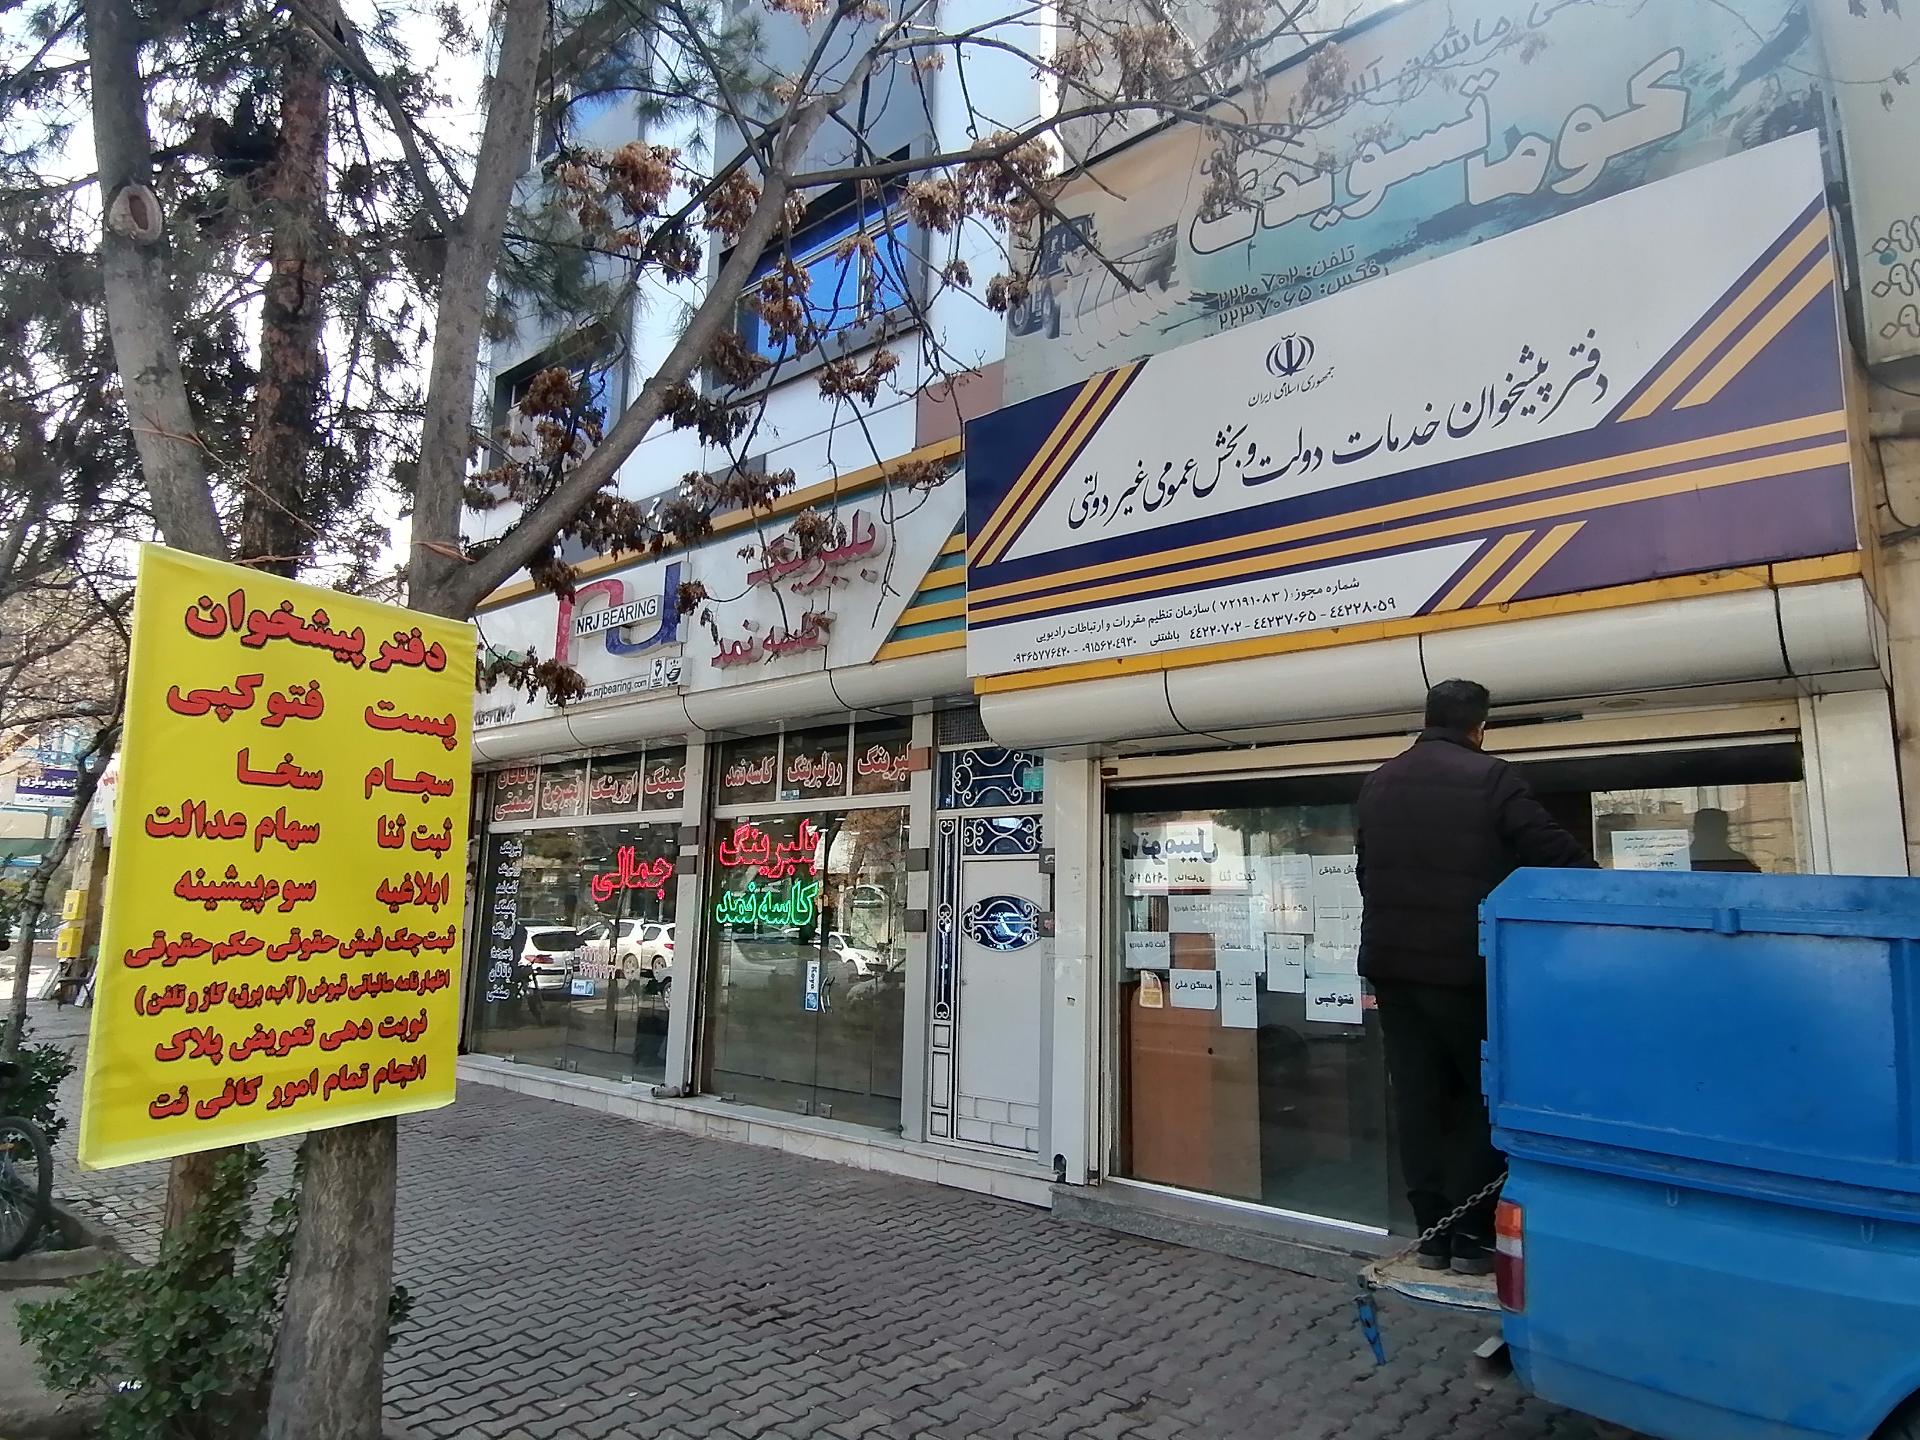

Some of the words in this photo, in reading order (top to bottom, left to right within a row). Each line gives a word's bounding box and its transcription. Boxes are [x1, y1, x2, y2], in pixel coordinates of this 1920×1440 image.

[1274, 382, 1299, 400] اسلامی
[1301, 366, 1335, 392] جمهوری
[1446, 342, 1553, 440] پیشخوان
[1537, 327, 1611, 424] دفتر
[1248, 392, 1272, 407] ایران
[1332, 402, 1441, 466] خدمات
[1192, 423, 1248, 498] بخش
[1242, 426, 1323, 487] دولت
[1068, 471, 1109, 529] دولتی
[1103, 457, 1148, 527] غیر
[1143, 458, 1198, 512] عمومی
[1326, 577, 1360, 595] شماره
[184, 588, 366, 670] پیشخوان
[576, 616, 600, 634] NRJ
[602, 598, 656, 628] BEARING
[1067, 619, 1104, 636] ارتباطات
[1112, 614, 1146, 628] مقررات
[1148, 609, 1173, 628] تنظیم
[1175, 603, 1210, 619] سازمان
[369, 626, 447, 672] دفتر
[1036, 626, 1066, 643] رادیویی
[364, 701, 457, 750] پست
[237, 747, 323, 790] سخا
[725, 758, 746, 788] نمد
[746, 755, 775, 786] کاسه
[787, 751, 843, 788] رولبرینگ
[857, 739, 912, 782] لبرینگ
[364, 759, 453, 803] سجام
[590, 771, 638, 804] اورینگ
[145, 799, 247, 840] عدالت
[254, 805, 320, 852] سهام
[377, 813, 405, 850] ثنا
[410, 815, 452, 859] ثبت
[720, 818, 821, 878] بلبرینگ
[591, 845, 675, 902] جمالی
[375, 871, 450, 914] ابلاغیه
[716, 882, 757, 924] نمد
[758, 880, 819, 926] کاسه
[124, 931, 213, 968] حقوقی
[212, 931, 265, 964] حکم
[266, 926, 339, 962] حقوقی
[338, 926, 383, 959] فیش
[385, 930, 427, 957] چک
[424, 925, 455, 955] ثبت
[186, 991, 198, 1013] و
[198, 981, 228, 1013] گاز
[306, 973, 348, 1003] قبوض
[348, 972, 394, 1002] مالیاتی
[229, 1019, 315, 1062] تعویض
[320, 1017, 373, 1050] دهی
[378, 1009, 427, 1042] نوبت
[155, 1026, 223, 1065] پلاک
[266, 1068, 318, 1109] امور
[324, 1063, 368, 1100] تمام
[373, 1056, 427, 1093] انجام
[148, 1085, 189, 1119] نت
[195, 1076, 262, 1119] کافی
